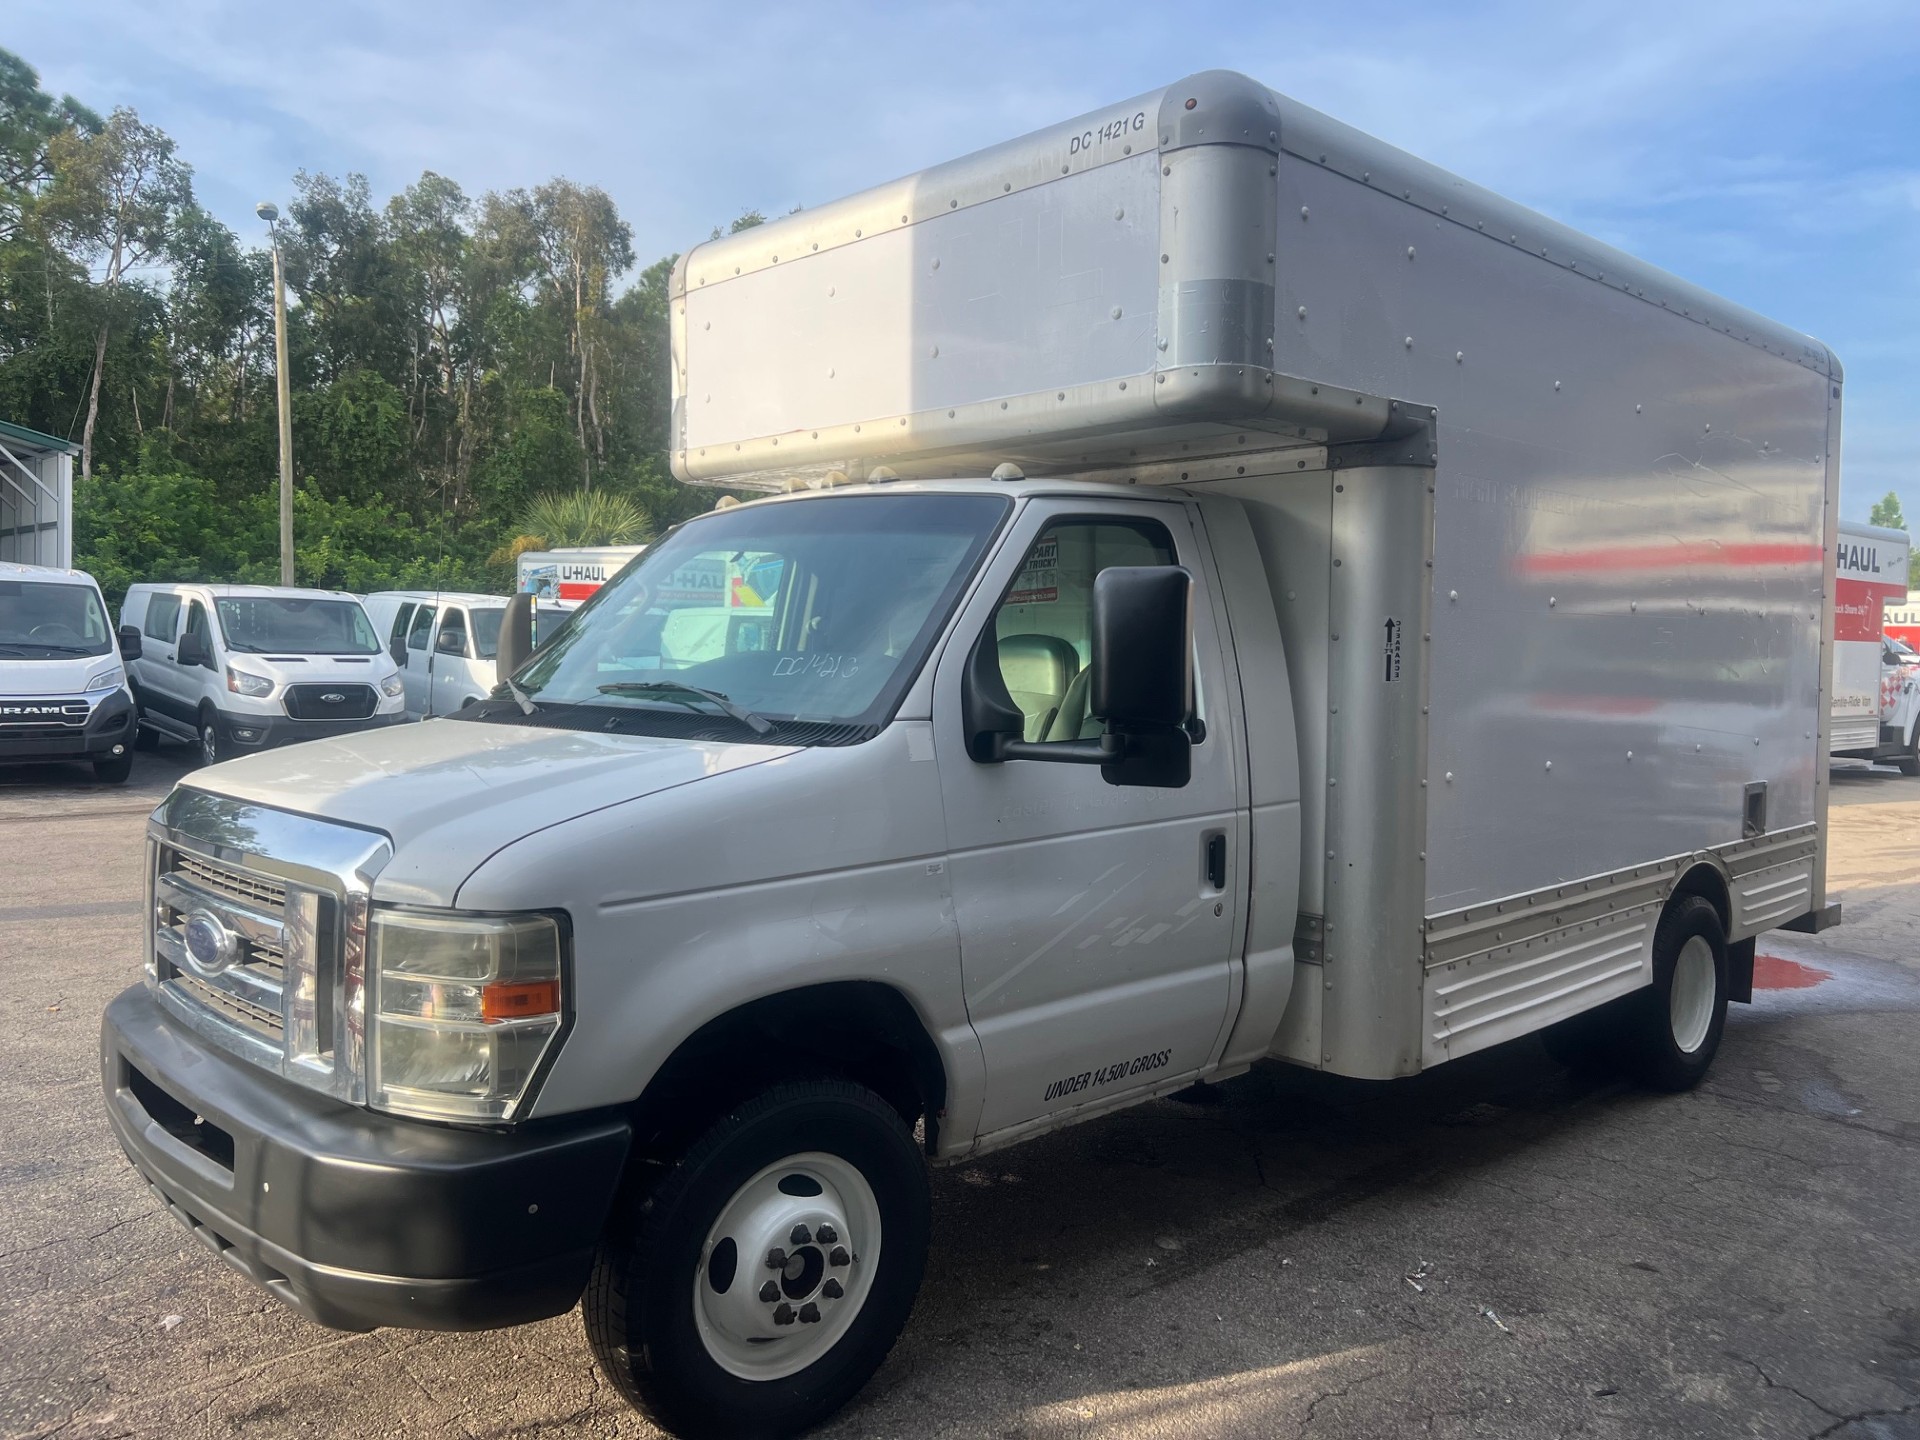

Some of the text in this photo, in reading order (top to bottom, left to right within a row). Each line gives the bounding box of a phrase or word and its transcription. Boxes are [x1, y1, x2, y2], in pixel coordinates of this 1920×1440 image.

[1070, 131, 1092, 155] DC
[1029, 558, 1057, 569] TRUCK?
[562, 566, 607, 581] U-HAUL
[1044, 1048, 1171, 1101] UNDER 14,500 GROSS
